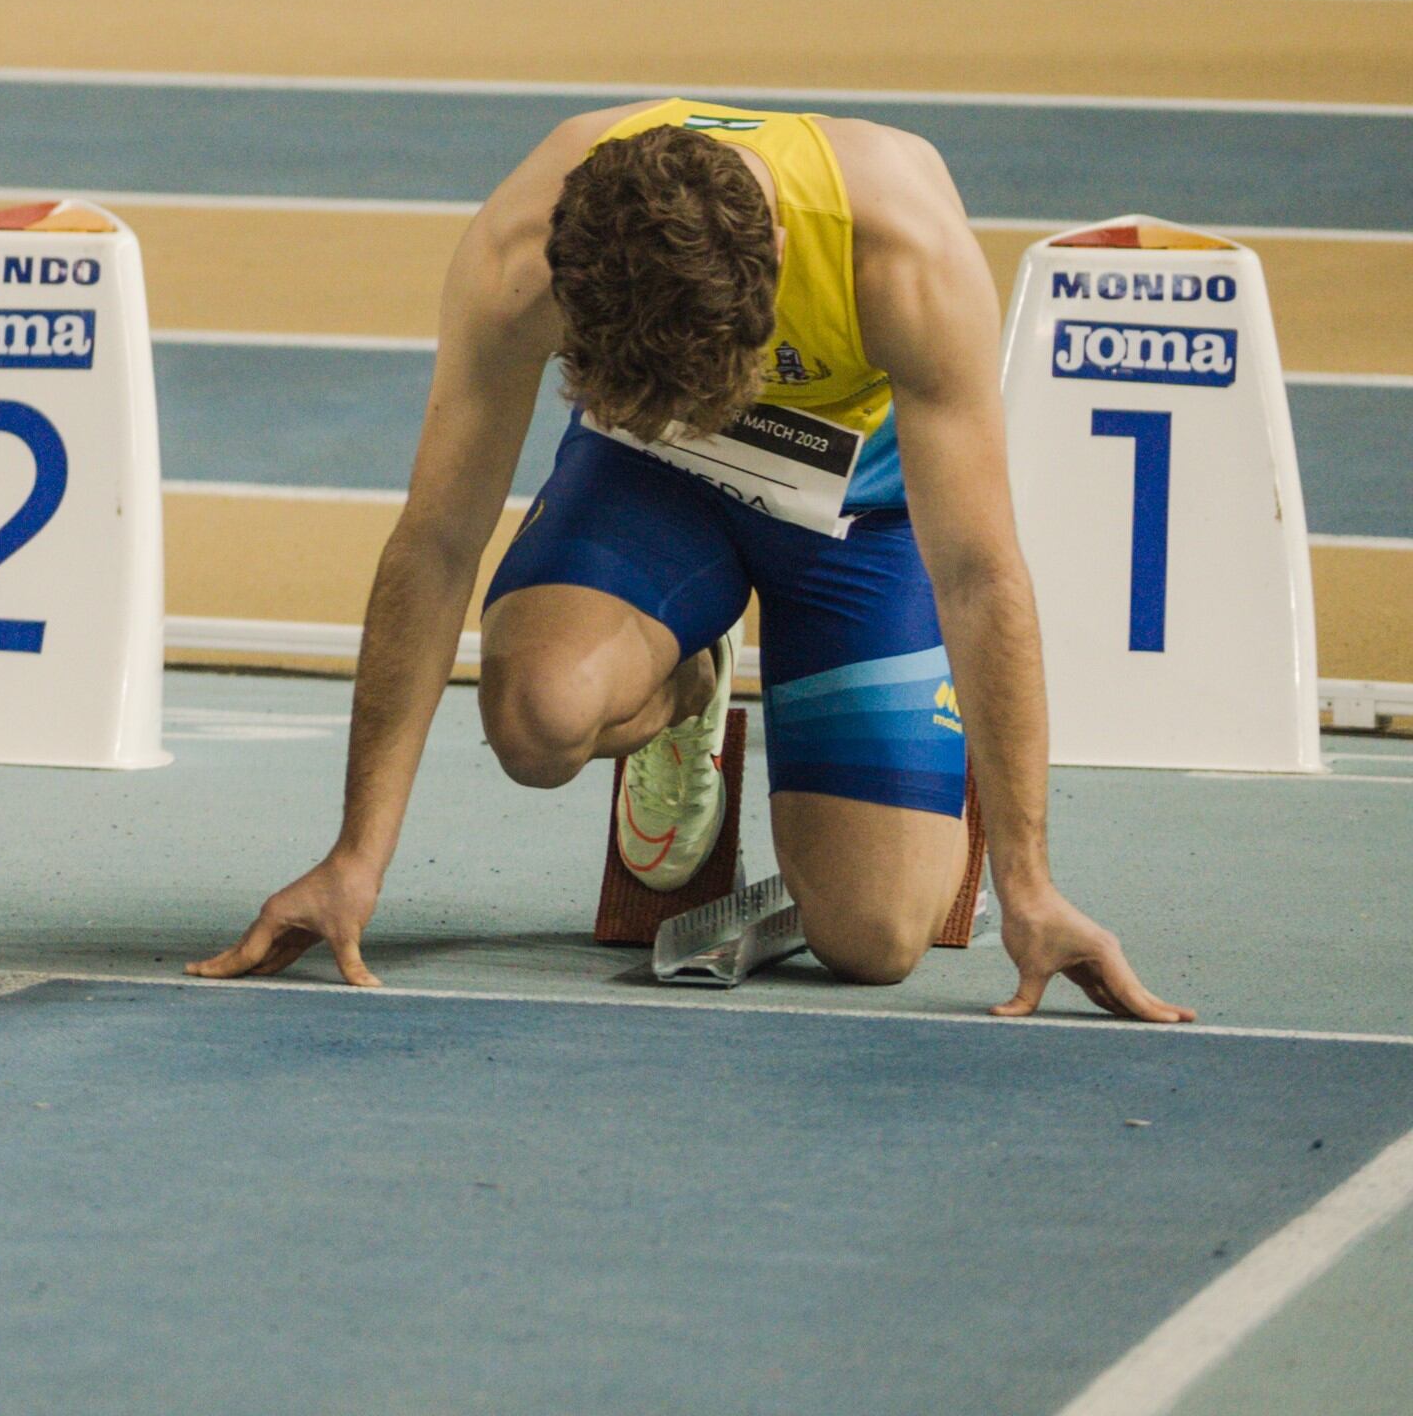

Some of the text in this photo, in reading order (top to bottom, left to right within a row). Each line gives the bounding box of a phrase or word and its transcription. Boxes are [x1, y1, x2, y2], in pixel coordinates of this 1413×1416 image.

[1052, 272, 1236, 302] MONDO
[742, 414, 794, 441] MATCH
[795, 430, 829, 454] 2023
[1090, 408, 1172, 653] 1
